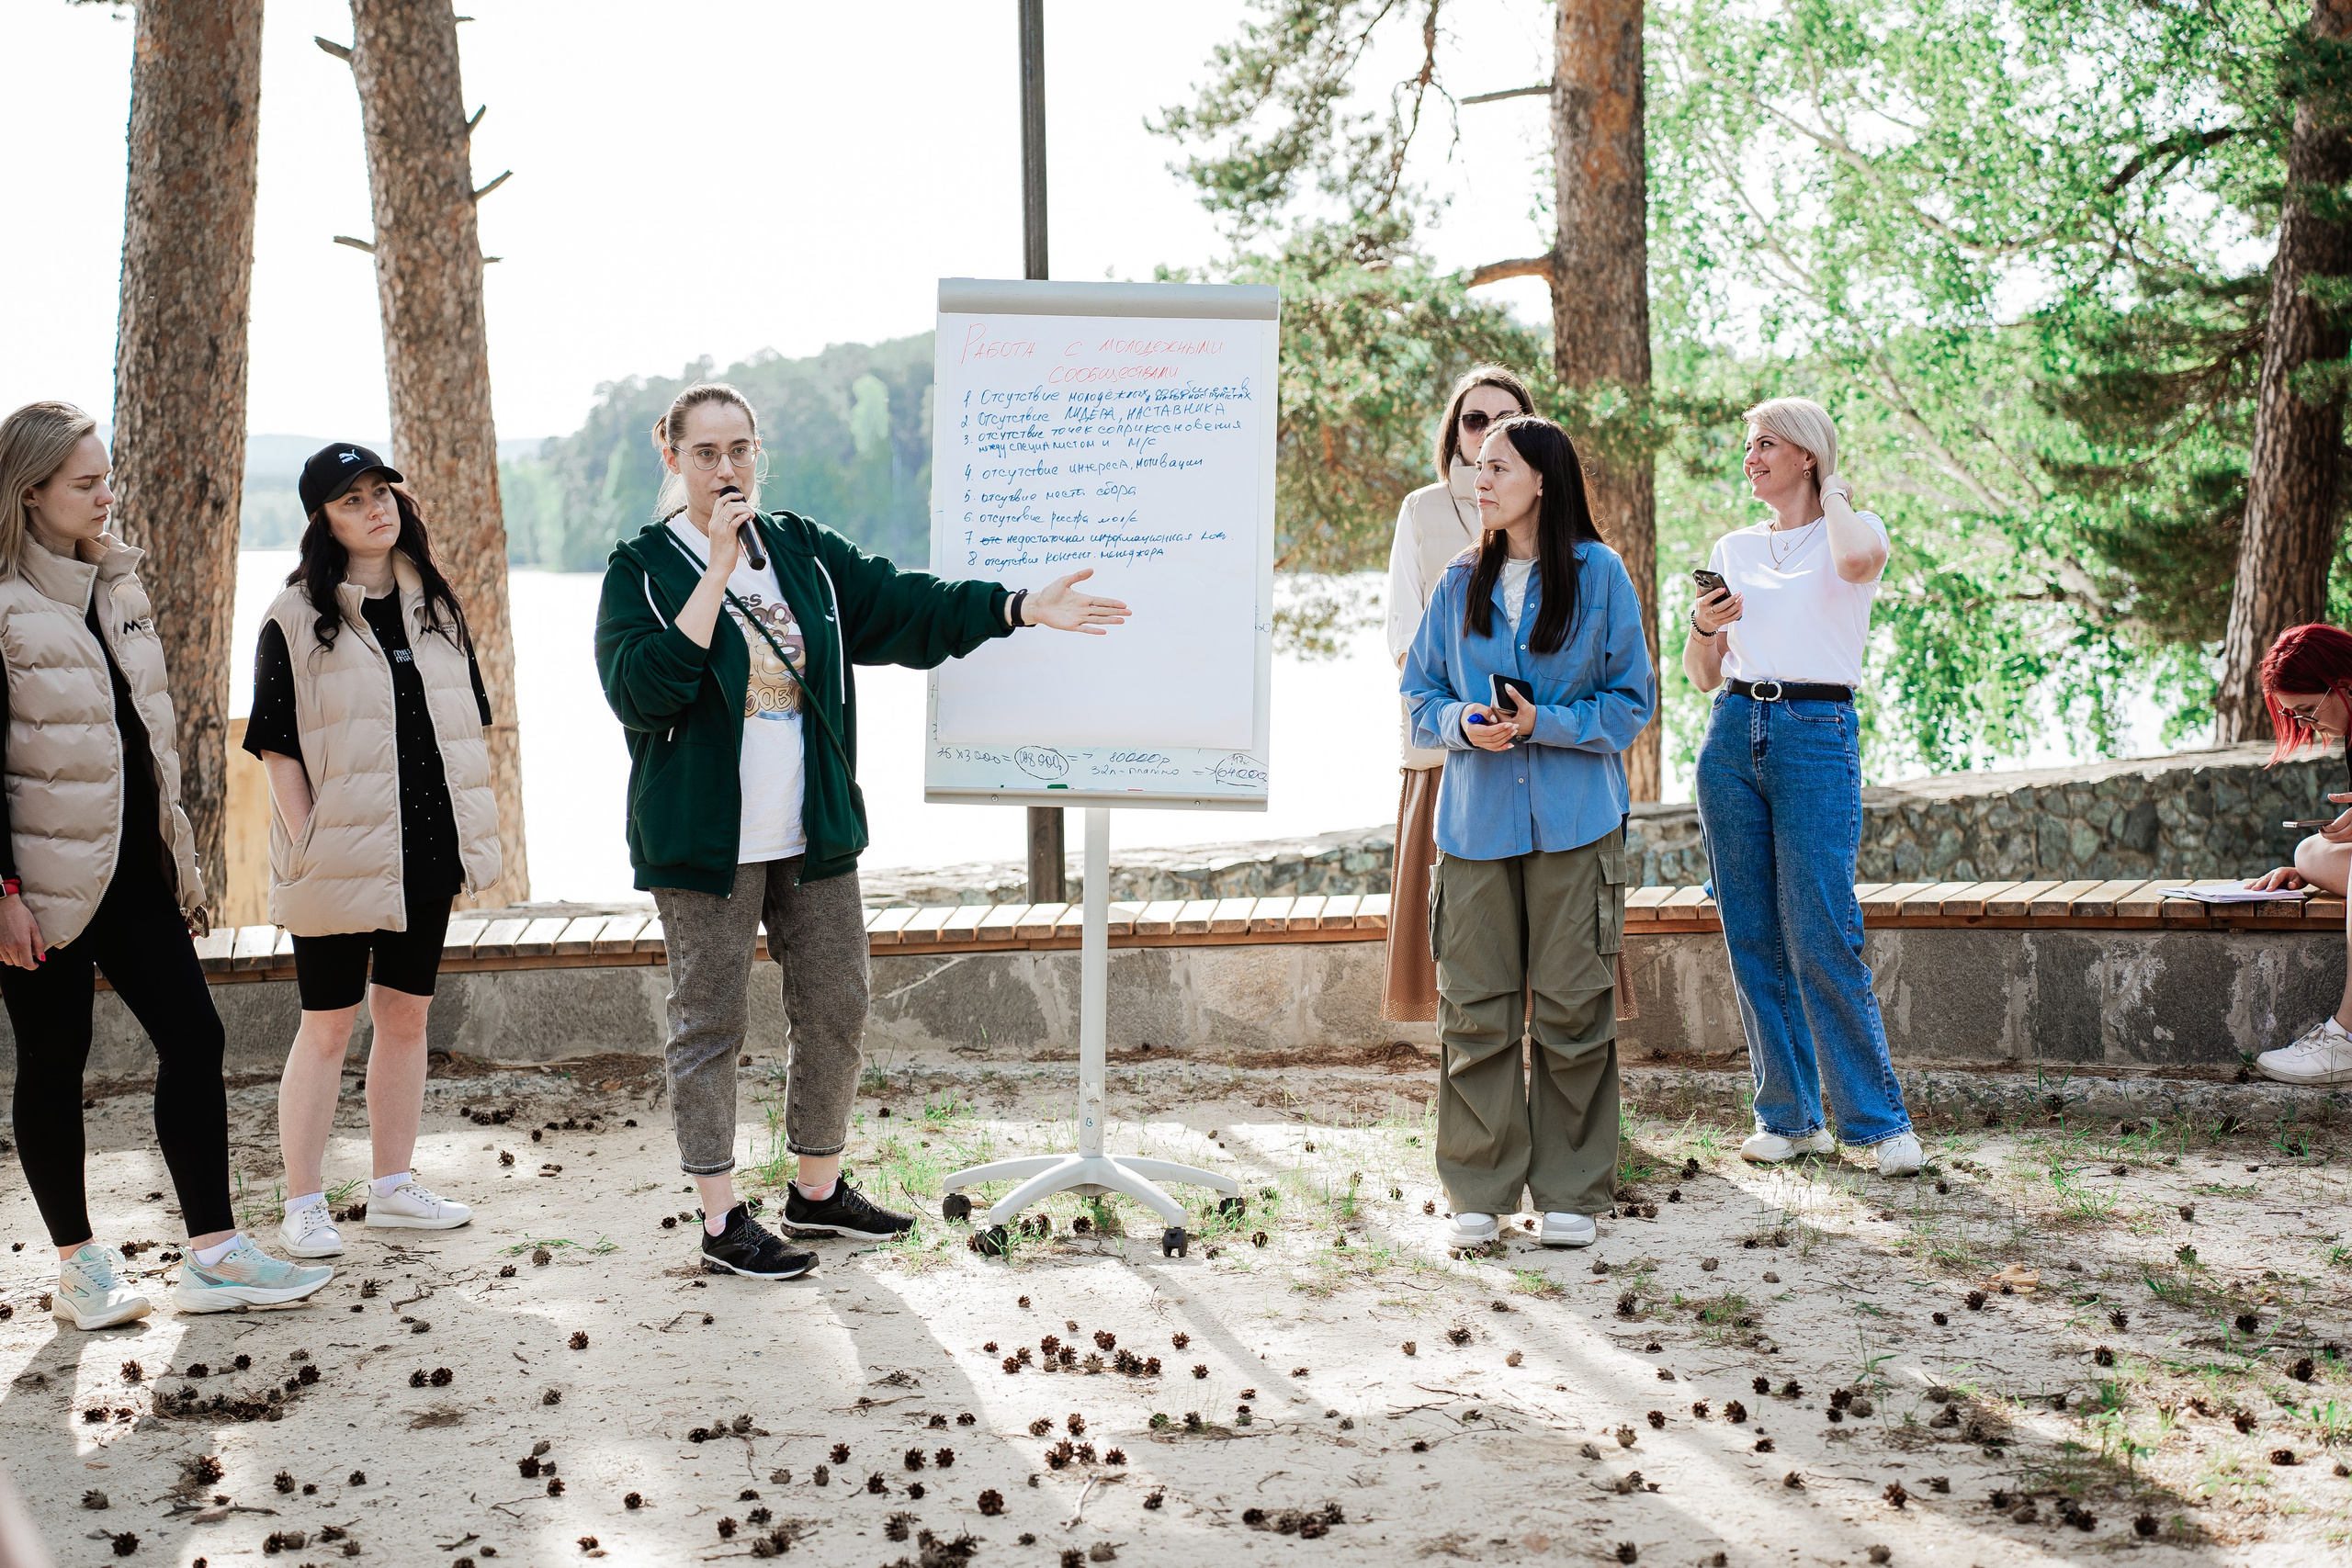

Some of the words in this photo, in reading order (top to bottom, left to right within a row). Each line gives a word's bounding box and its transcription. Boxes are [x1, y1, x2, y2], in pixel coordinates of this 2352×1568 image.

[980, 385, 1059, 409] Отсутствие
[978, 407, 1050, 430] Отсутствие
[1127, 402, 1225, 421] НАСТАВНИКА
[978, 424, 1045, 441] отсутствие
[1098, 418, 1241, 436] соприкосновения
[982, 459, 1058, 485] отсутствие
[1096, 481, 1136, 502] сбора
